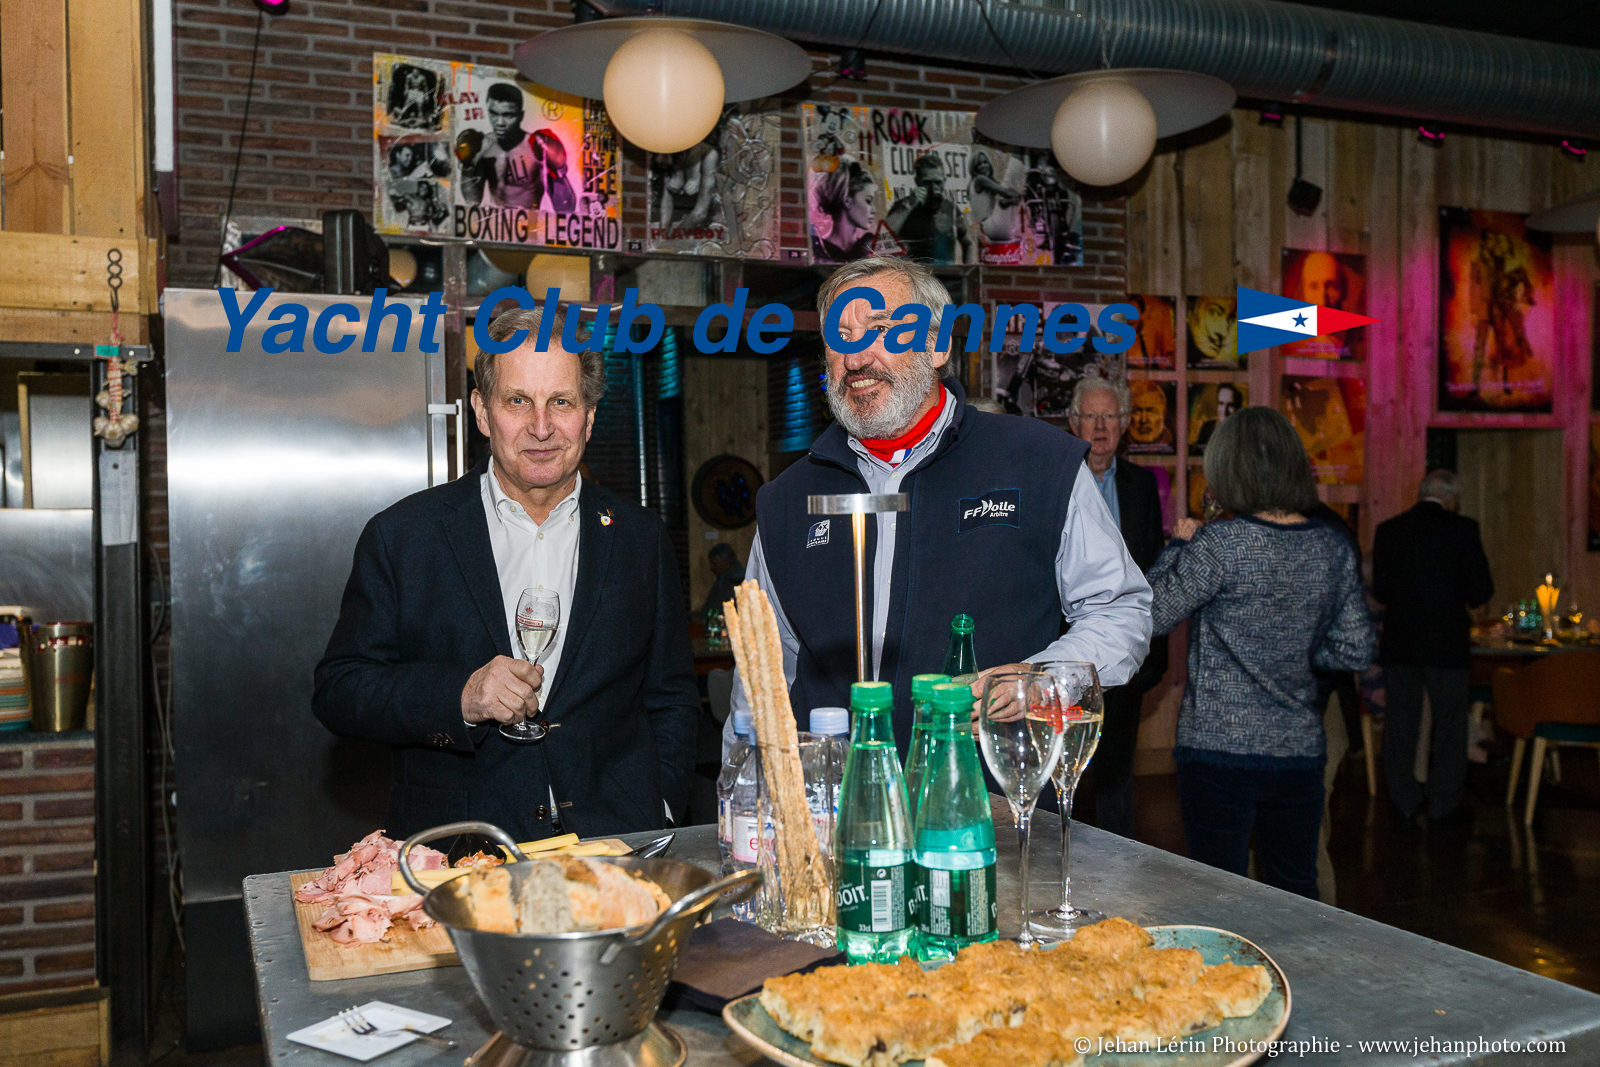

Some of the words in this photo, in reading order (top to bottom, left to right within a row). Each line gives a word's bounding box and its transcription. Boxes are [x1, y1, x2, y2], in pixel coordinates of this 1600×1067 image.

[872, 109, 932, 145] ROCK
[945, 151, 967, 178] SET
[583, 166, 618, 195] BEE
[454, 204, 528, 243] BOXING
[545, 212, 619, 249] LEGEND
[651, 227, 725, 240] PLAYBOY
